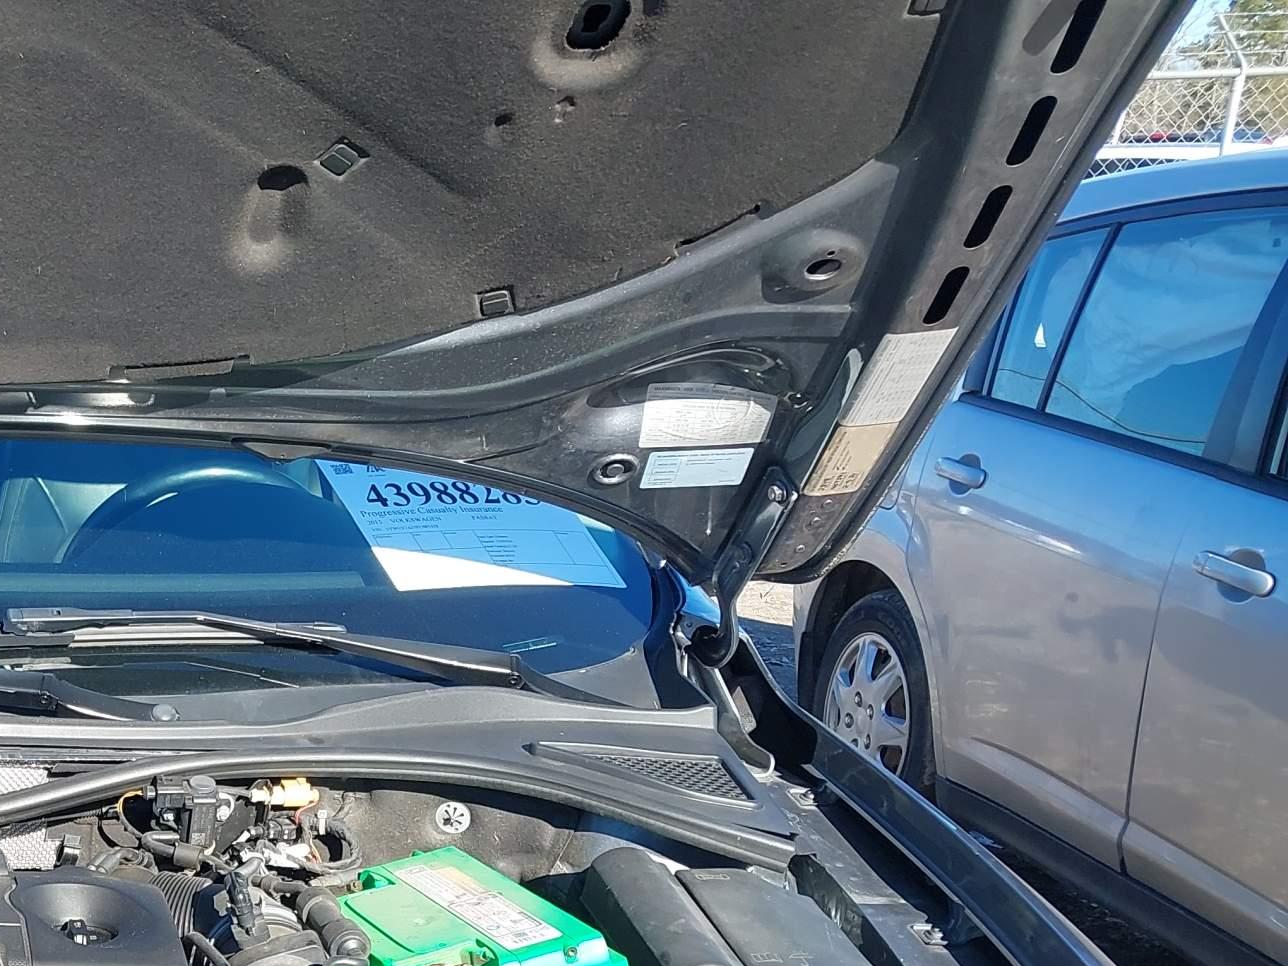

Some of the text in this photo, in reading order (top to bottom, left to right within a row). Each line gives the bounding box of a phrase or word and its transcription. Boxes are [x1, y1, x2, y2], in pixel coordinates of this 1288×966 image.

[360, 505, 504, 518] Progressive Casualty Insurance
[390, 516, 442, 524] VOLKSWAGEN
